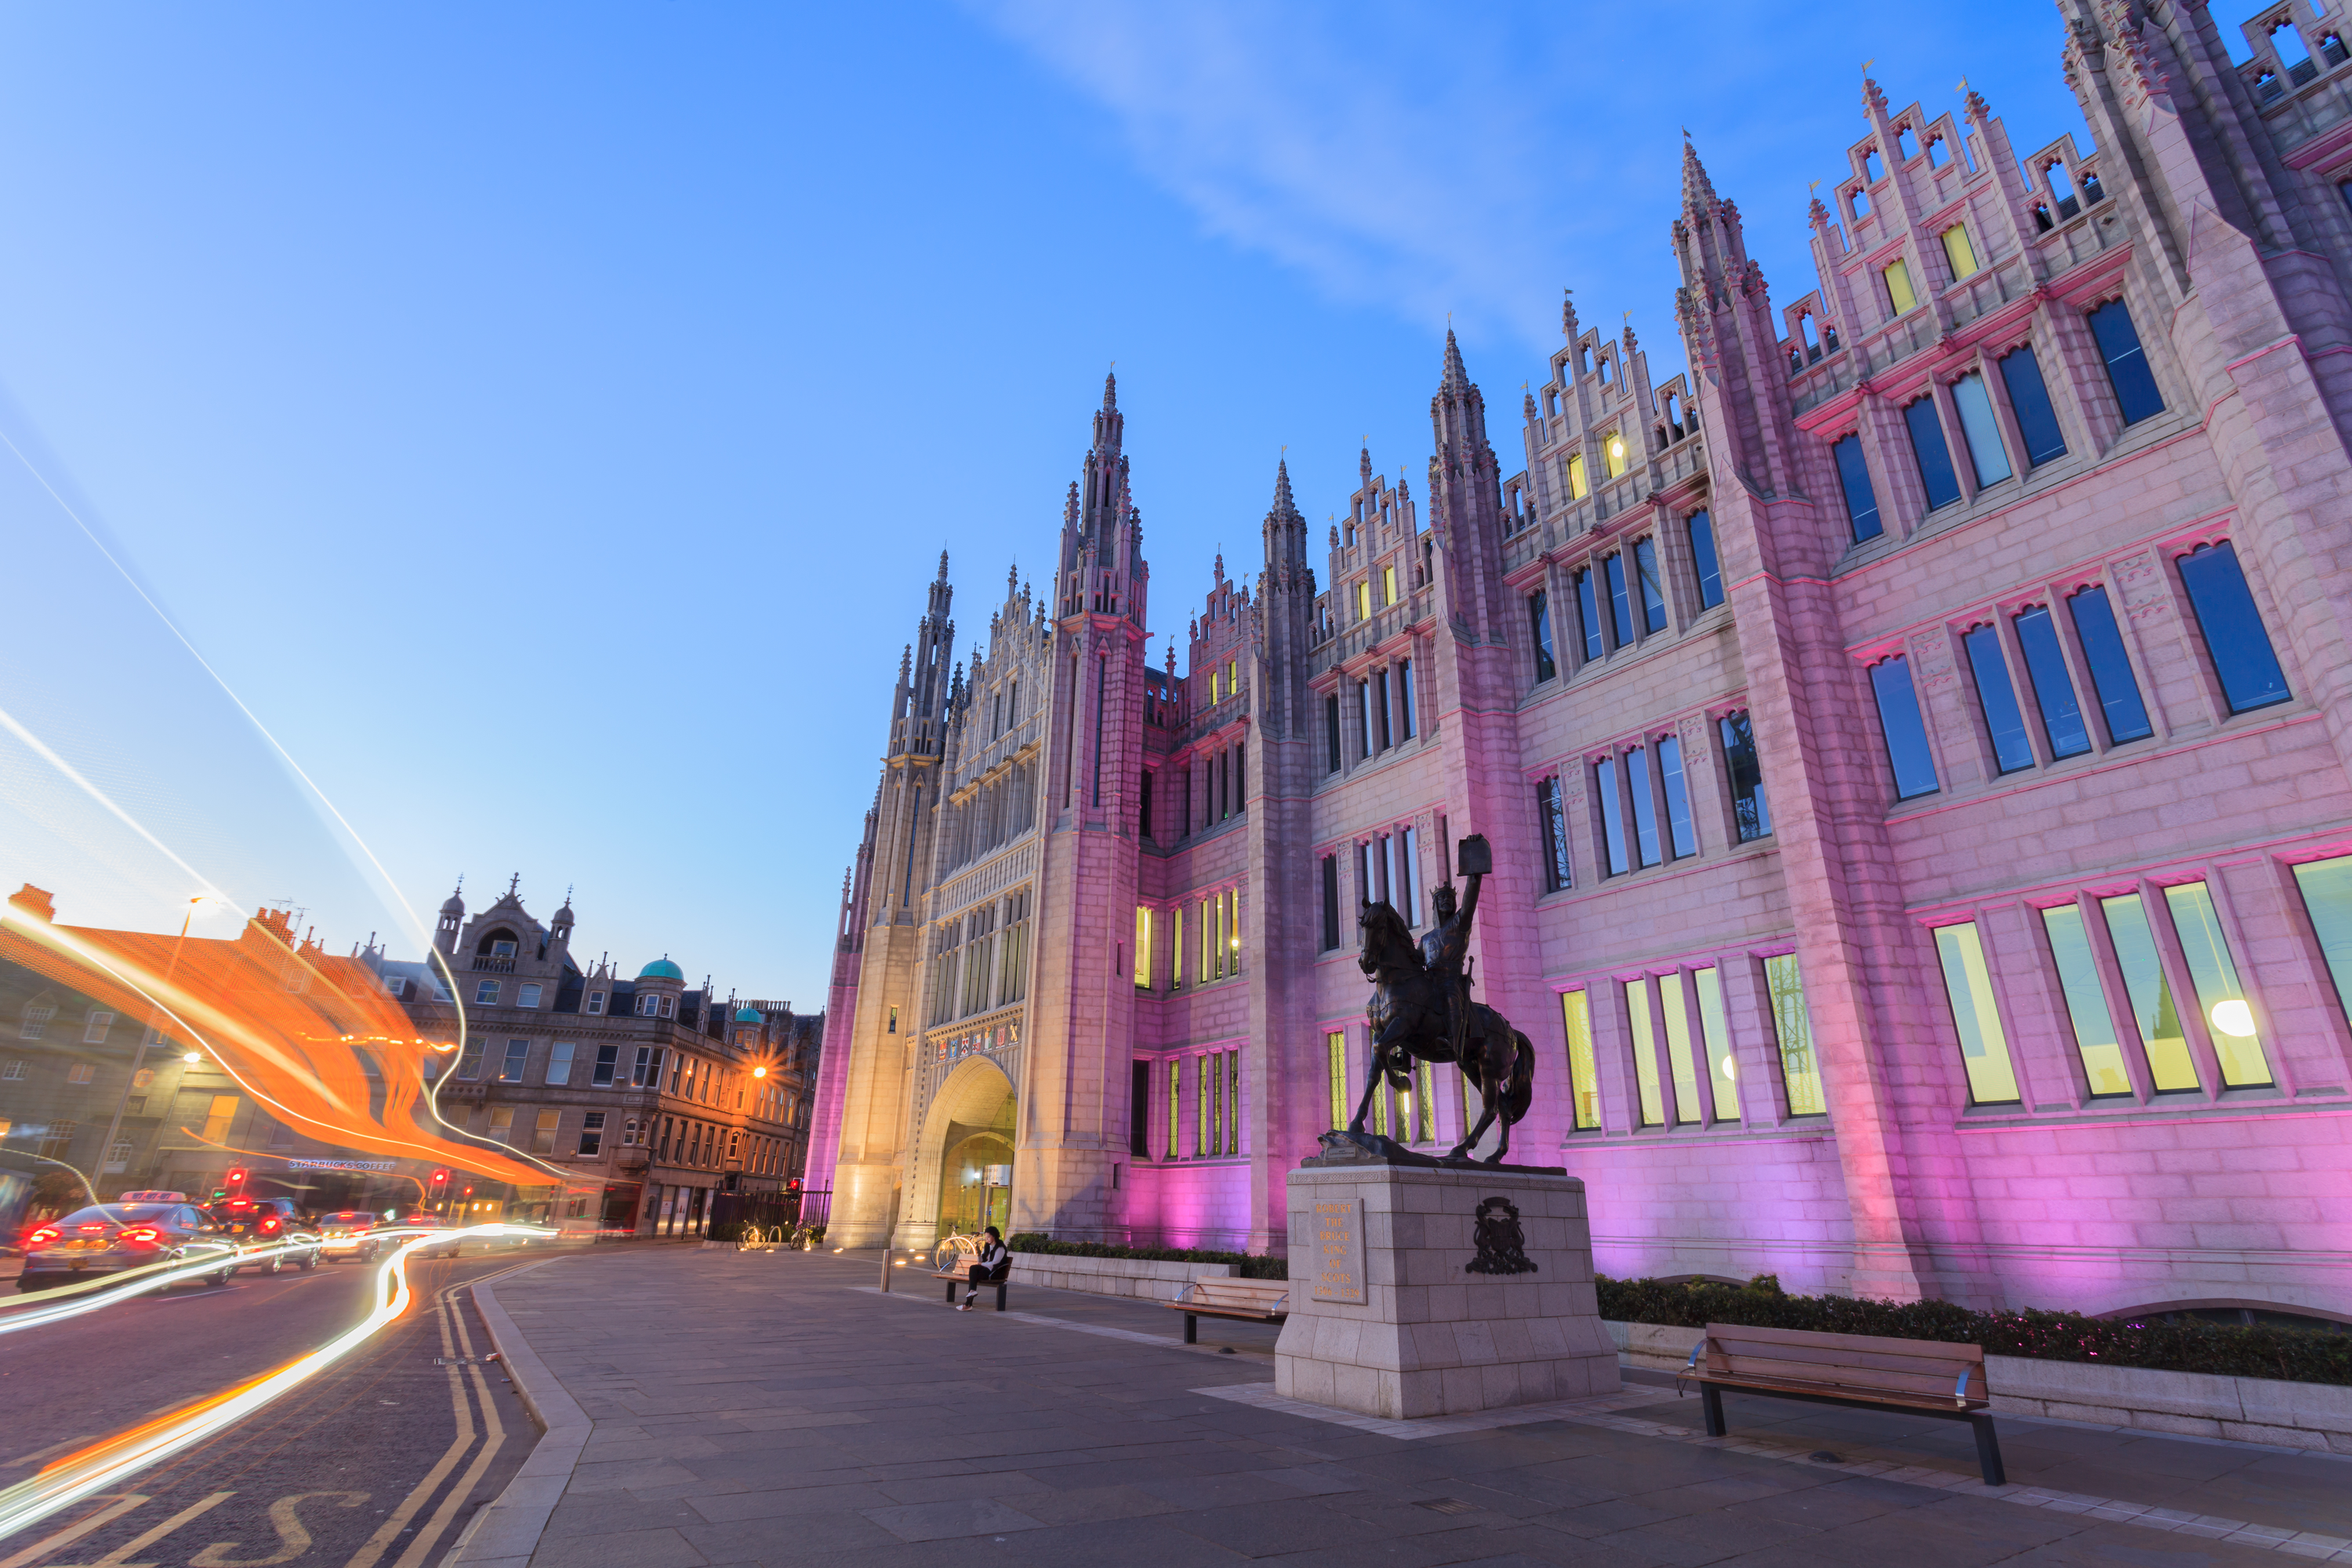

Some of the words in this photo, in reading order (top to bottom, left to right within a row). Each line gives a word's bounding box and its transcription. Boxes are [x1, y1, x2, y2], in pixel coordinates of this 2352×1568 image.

[289, 1160, 353, 1169] STARBUCKS
[356, 1161, 395, 1170] COFFEE
[1316, 1203, 1352, 1214] ROBERT
[1325, 1218, 1343, 1227] THE
[1319, 1231, 1350, 1240] BRUCE
[1323, 1245, 1347, 1254] KING
[1329, 1258, 1341, 1269] OF
[1321, 1272, 1351, 1283] SCOTS
[1315, 1286, 1332, 1296] 1306
[1341, 1288, 1359, 1298] 1329
